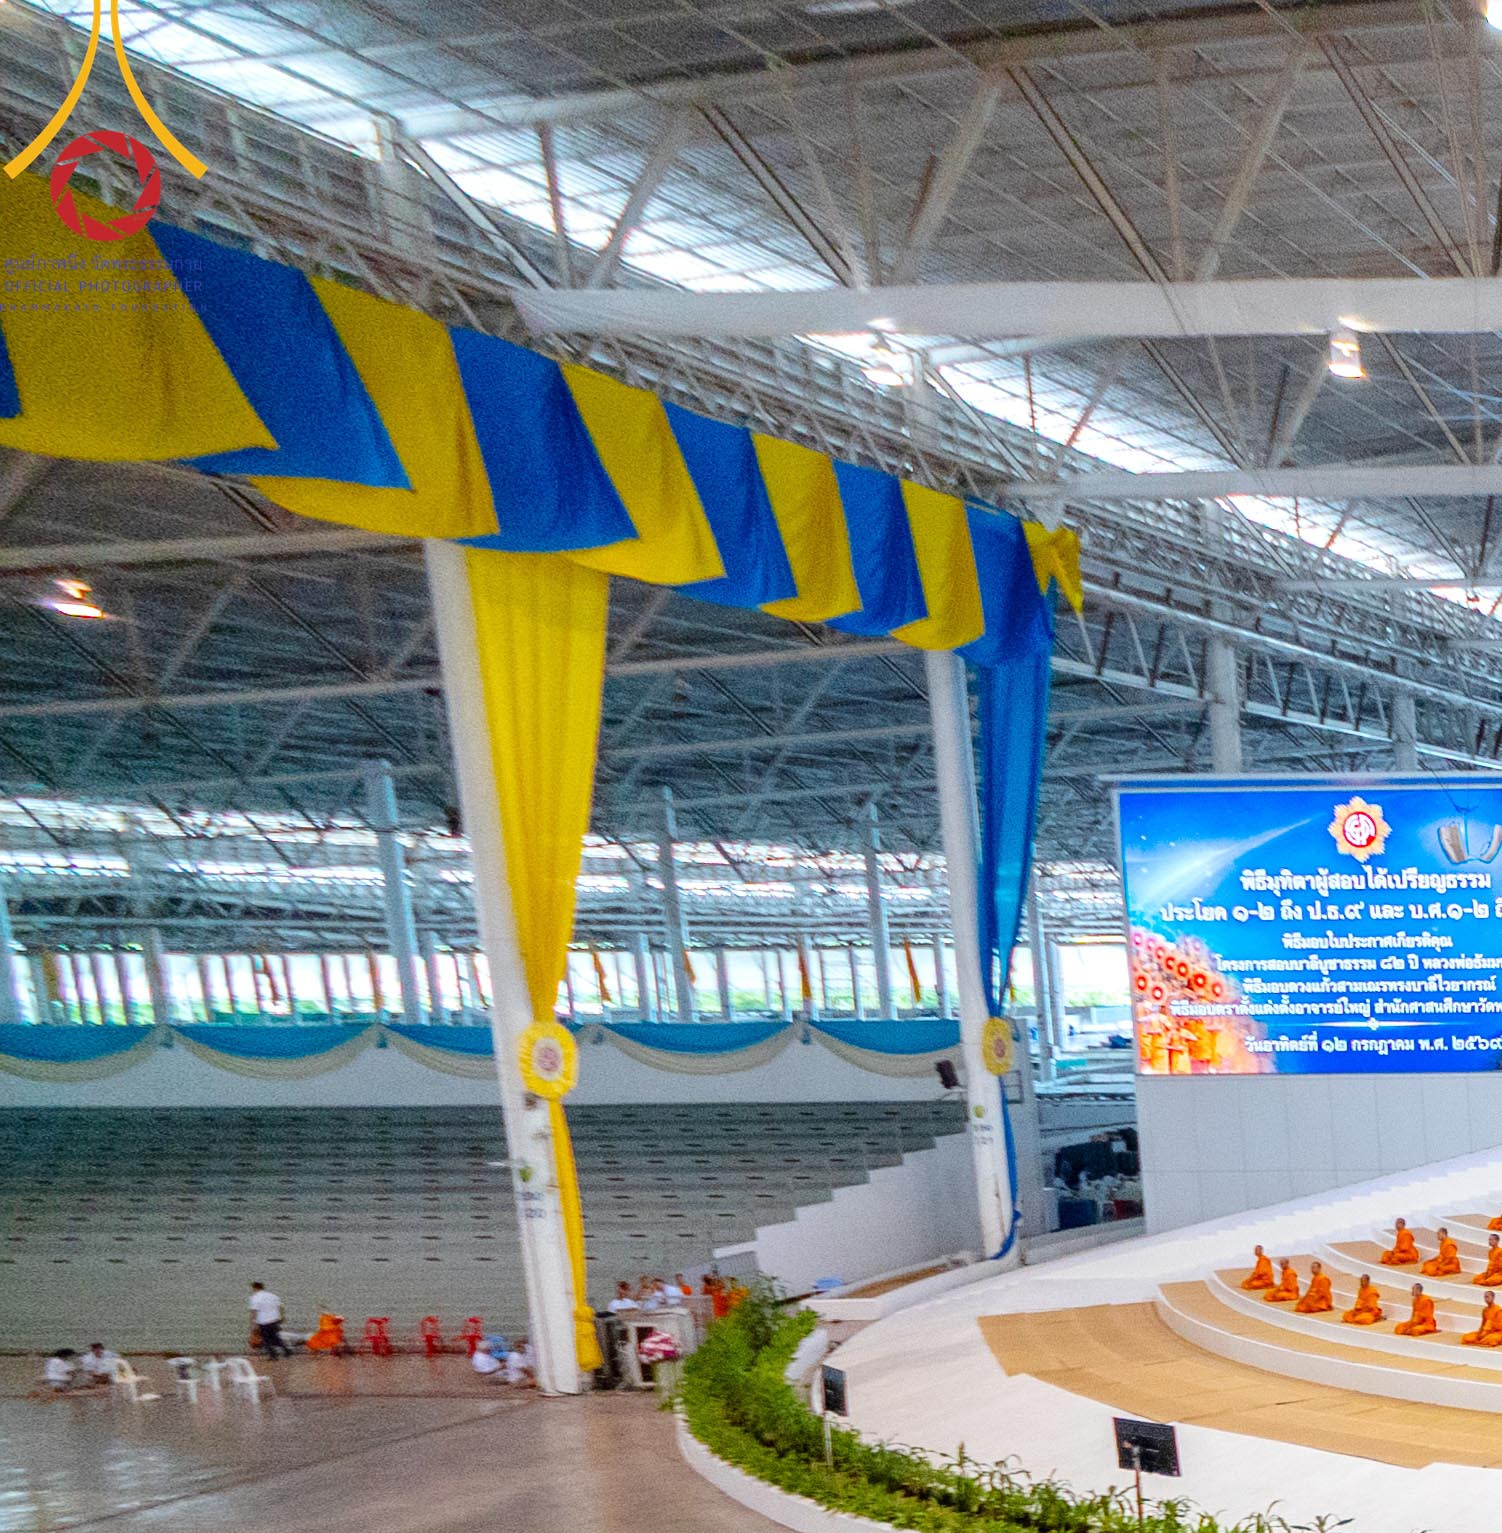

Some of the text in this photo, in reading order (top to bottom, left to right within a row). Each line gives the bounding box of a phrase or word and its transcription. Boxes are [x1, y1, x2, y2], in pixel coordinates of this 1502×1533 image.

[1240, 865, 1491, 897] พิธีมุทิตาผู้สอบได้เปรียญธรรม
[1160, 897, 1227, 921] ประโยค
[1232, 901, 1275, 922] ๑-๒
[1280, 898, 1303, 920] ถึง
[1307, 900, 1365, 920] ป.ธ.๙
[1369, 903, 1404, 919] และ
[1281, 930, 1454, 952] พิธีมอบใบประกาศเกียรติคุณ
[1407, 954, 1419, 969] ปี
[1244, 1030, 1318, 1052] วันอาทิตย์ที่
[1321, 1036, 1347, 1053] ๑๒
[1351, 1037, 1414, 1055] กรกฎาคม
[1418, 1036, 1448, 1050] พ.ศ.
